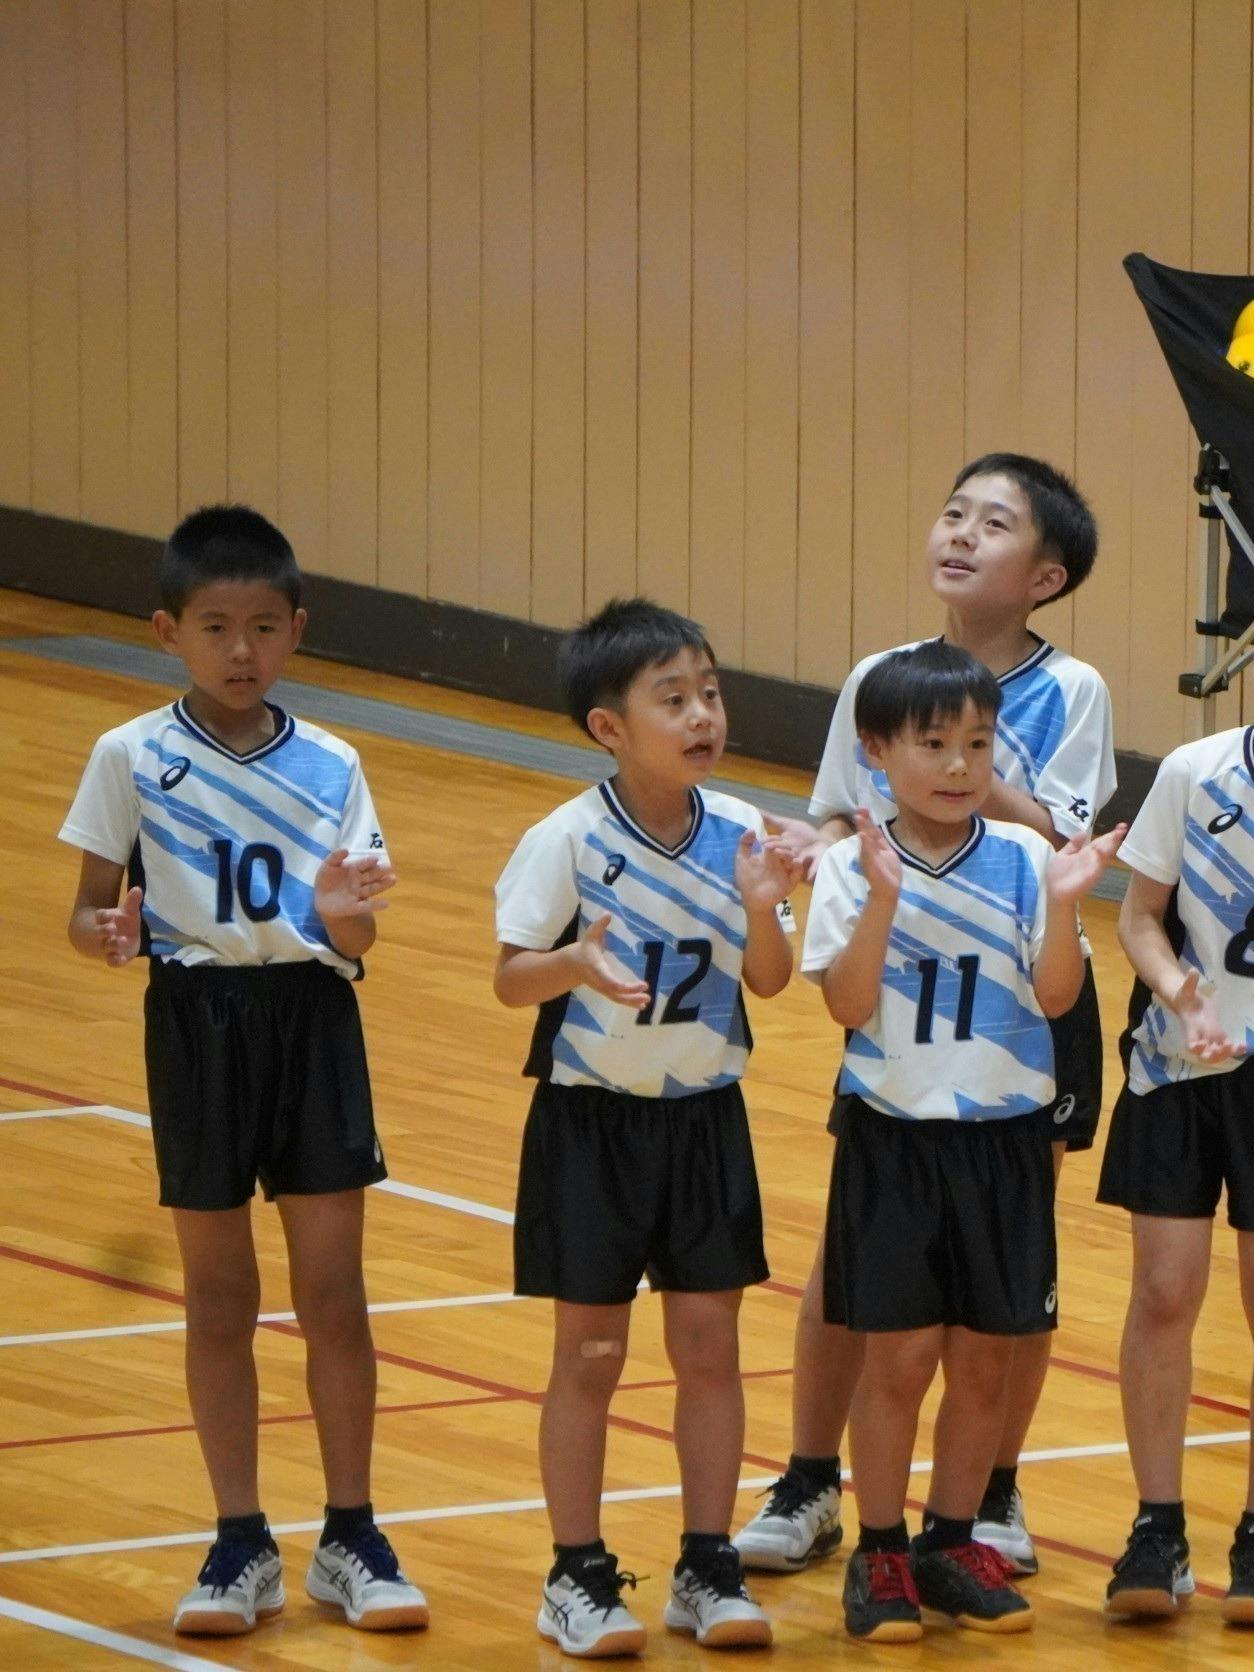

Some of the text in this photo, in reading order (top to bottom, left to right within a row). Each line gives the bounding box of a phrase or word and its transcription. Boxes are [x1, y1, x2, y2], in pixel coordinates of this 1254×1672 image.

[213, 838, 285, 924] 10
[635, 937, 713, 1026] 12
[915, 953, 980, 1045] 11
